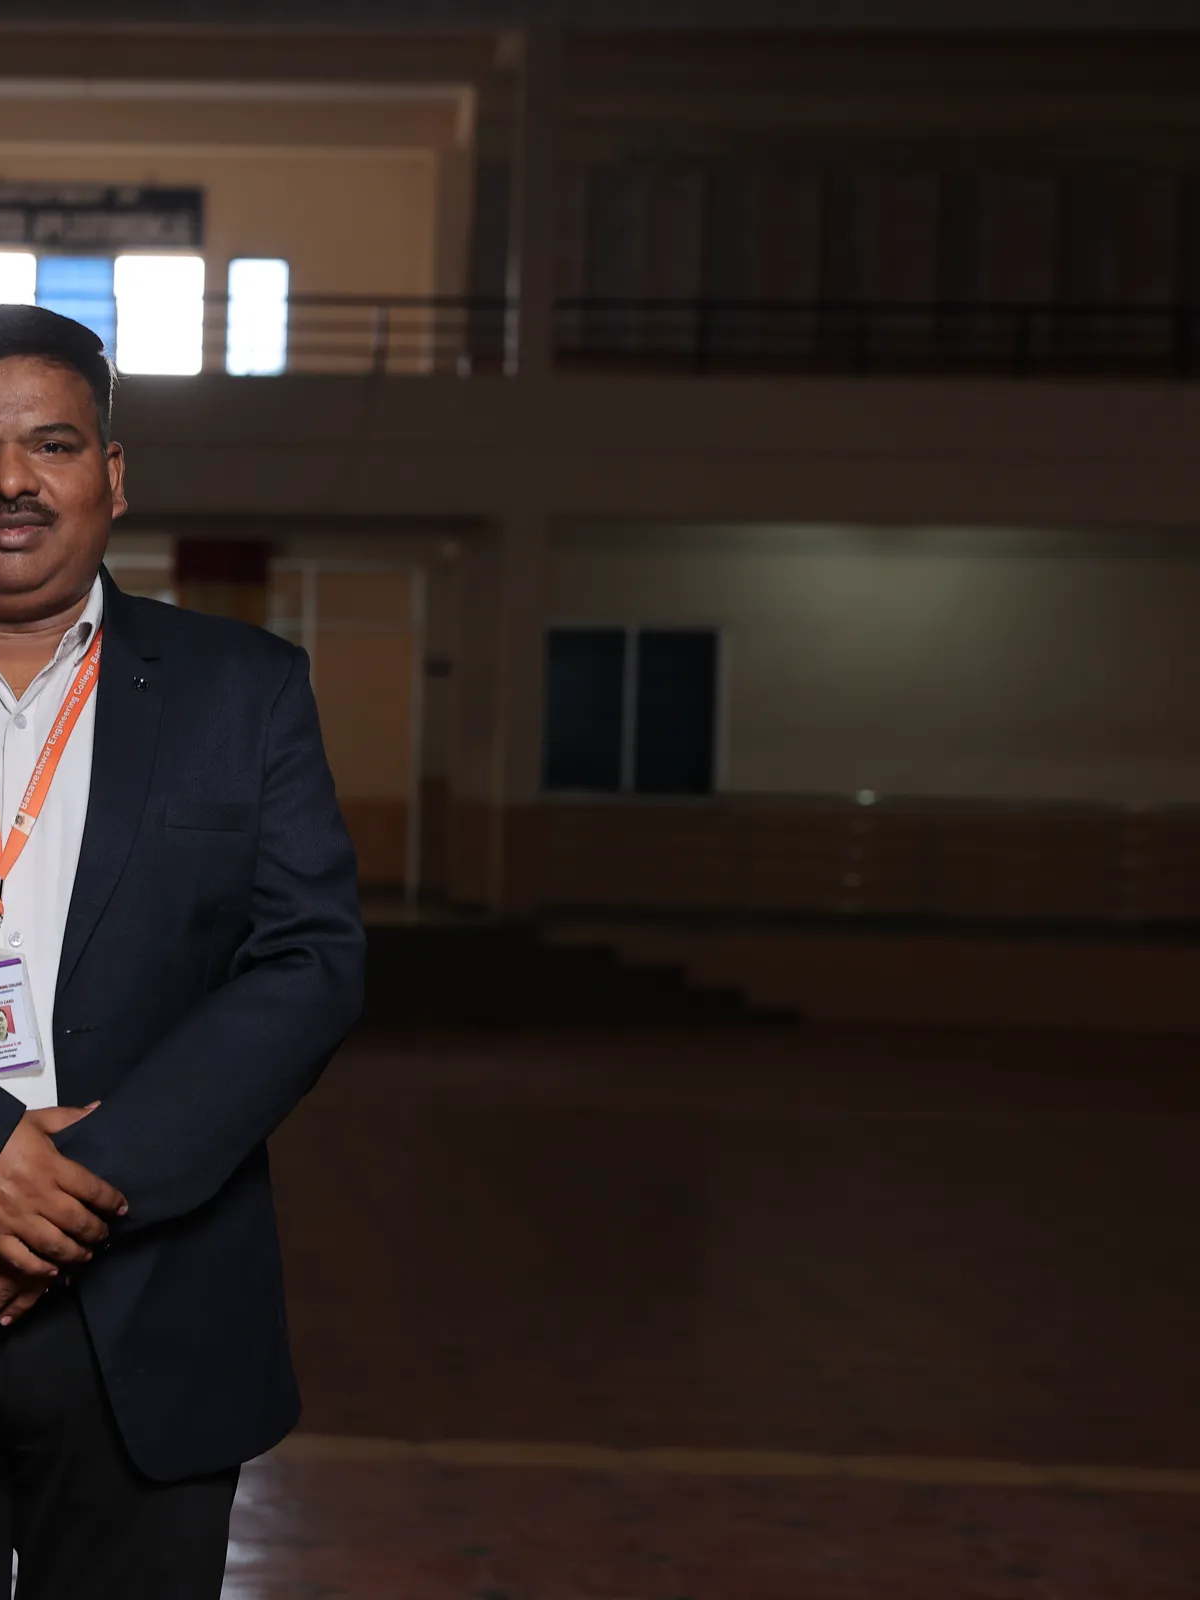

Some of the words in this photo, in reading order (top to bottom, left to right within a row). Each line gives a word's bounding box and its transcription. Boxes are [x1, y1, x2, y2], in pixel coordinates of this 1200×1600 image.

[19, 746, 52, 810] Basaveshwar
[47, 696, 80, 745] Engineering
[74, 665, 95, 695] College
